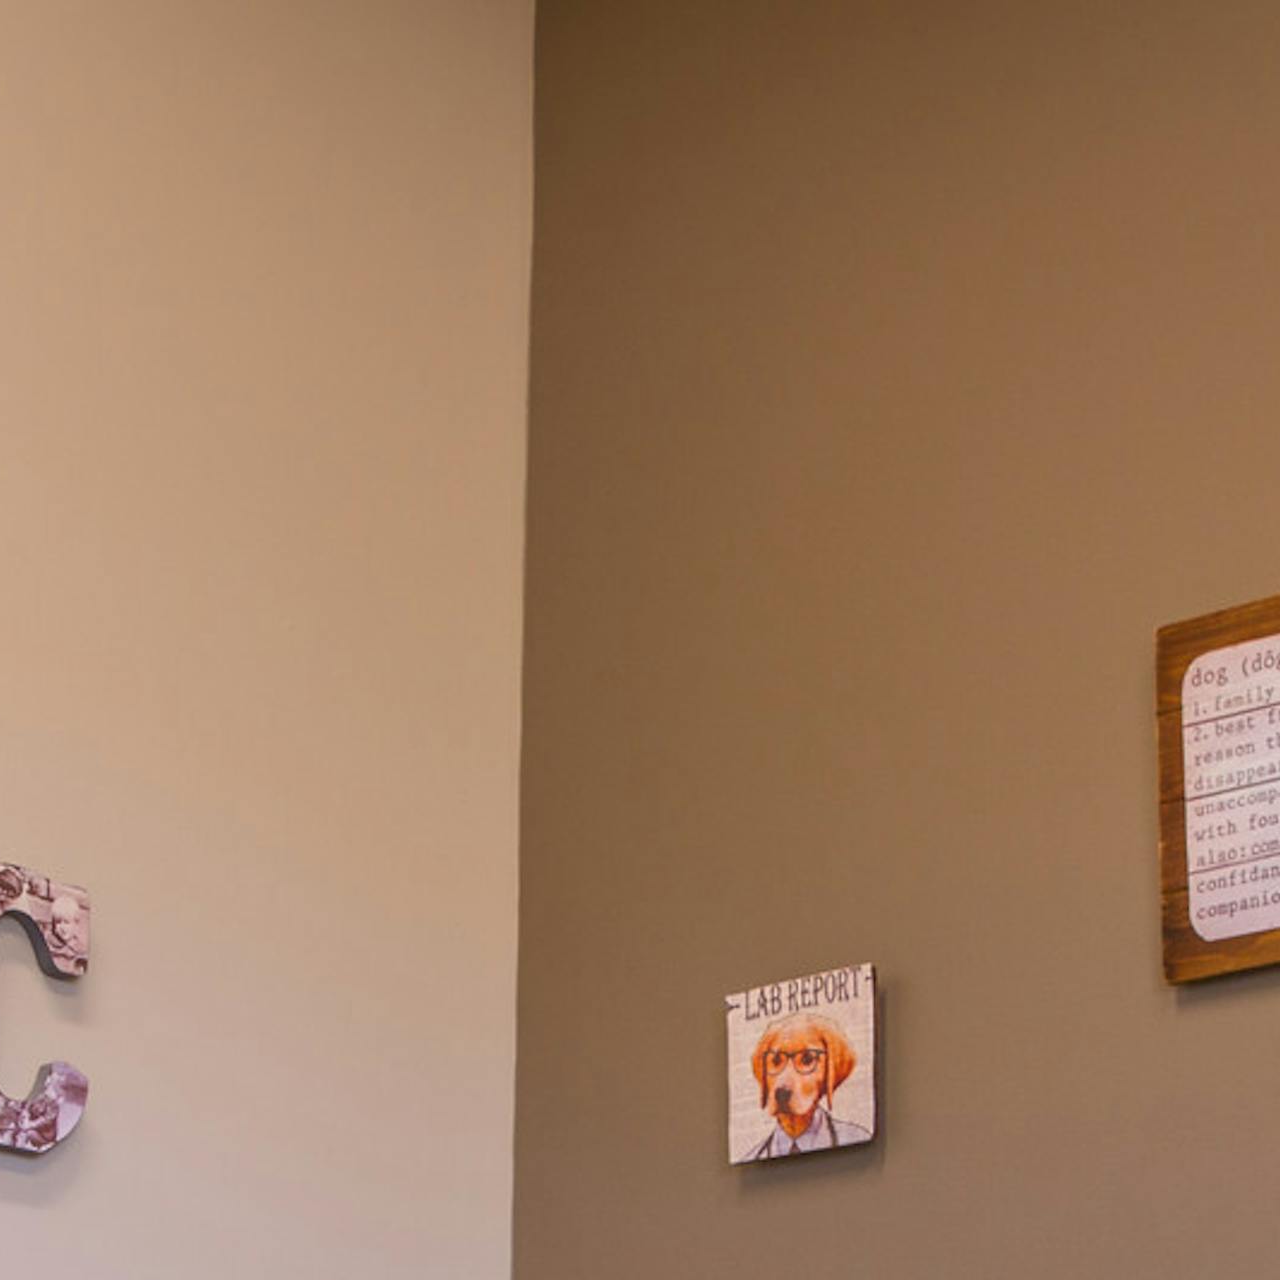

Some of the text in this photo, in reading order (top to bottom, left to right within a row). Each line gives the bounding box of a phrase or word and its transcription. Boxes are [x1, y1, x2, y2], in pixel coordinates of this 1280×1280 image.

[1191, 664, 1229, 688] dog
[1214, 683, 1274, 712] family
[1215, 715, 1255, 739] best
[1194, 740, 1256, 767] reason
[1194, 818, 1237, 842] with
[1196, 847, 1246, 868] also:
[744, 967, 861, 1021] LAB REPORT
